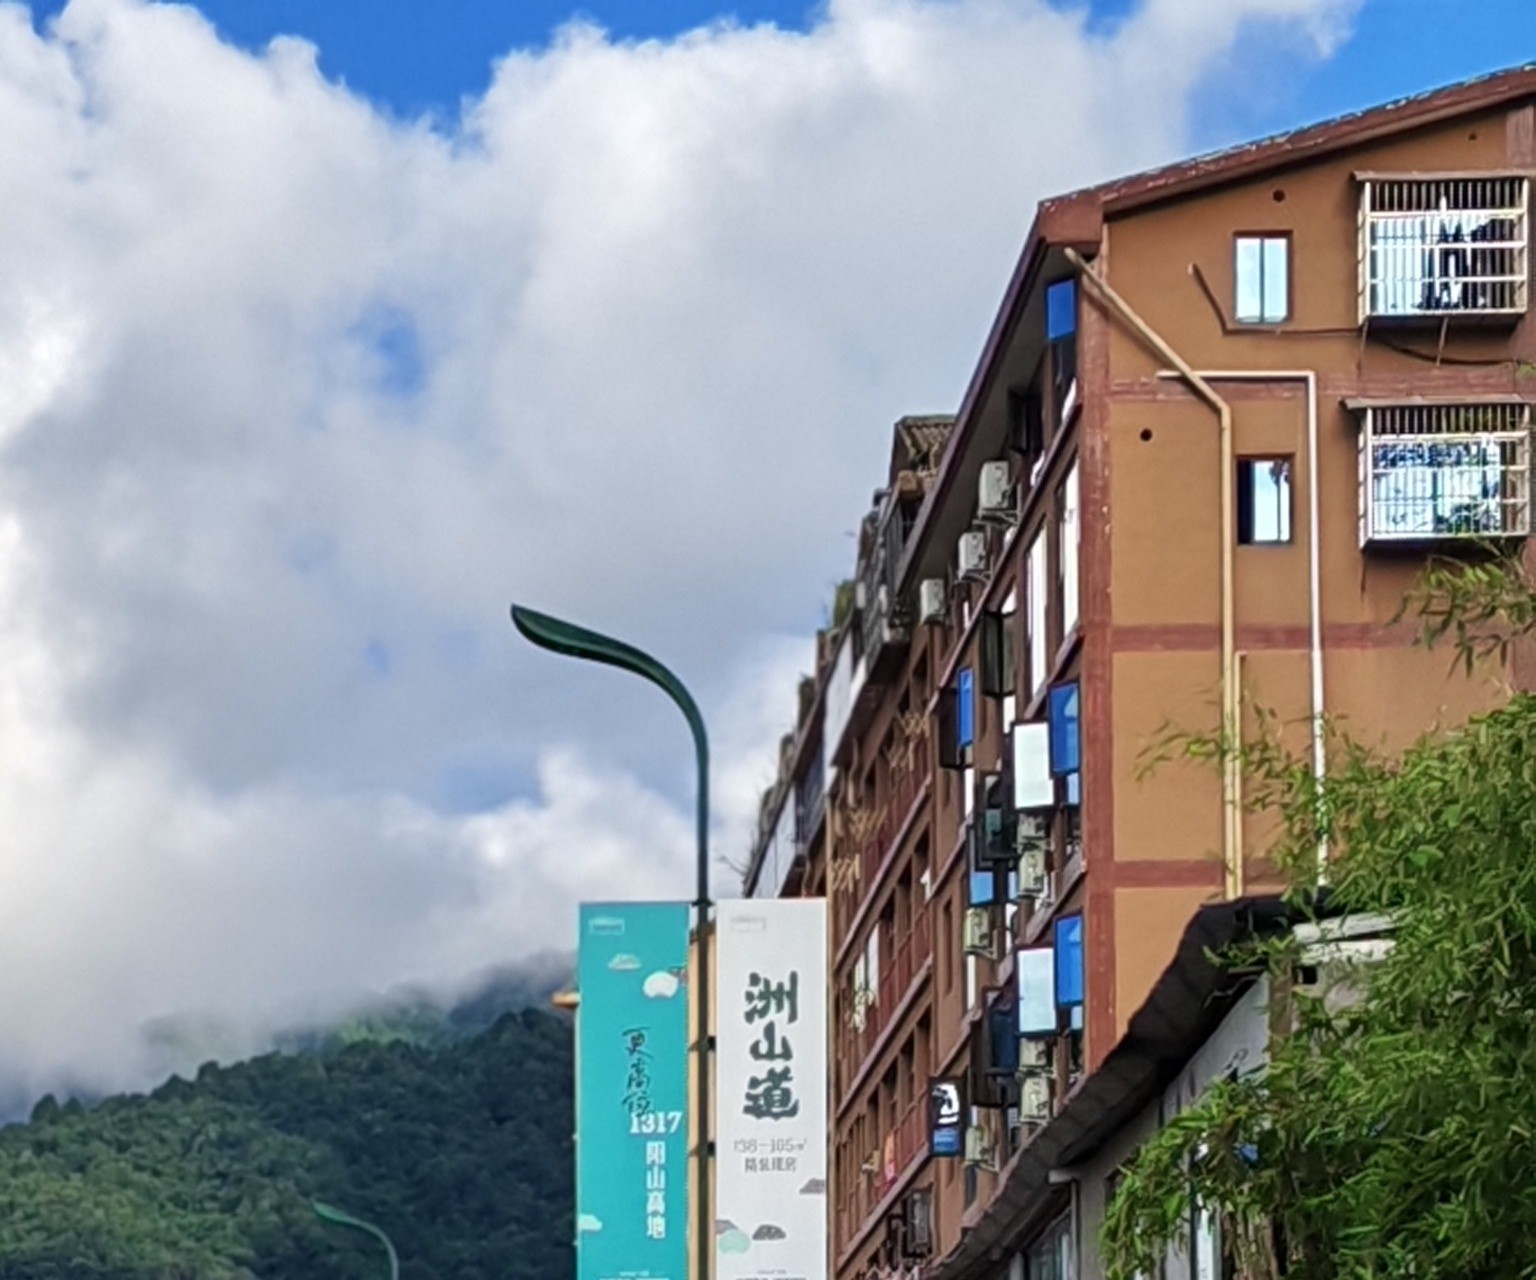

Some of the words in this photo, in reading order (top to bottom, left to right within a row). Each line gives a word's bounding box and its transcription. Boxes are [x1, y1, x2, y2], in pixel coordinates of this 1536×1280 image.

[742, 970, 799, 1121] 洲山道
[629, 1111, 683, 1134] 1317
